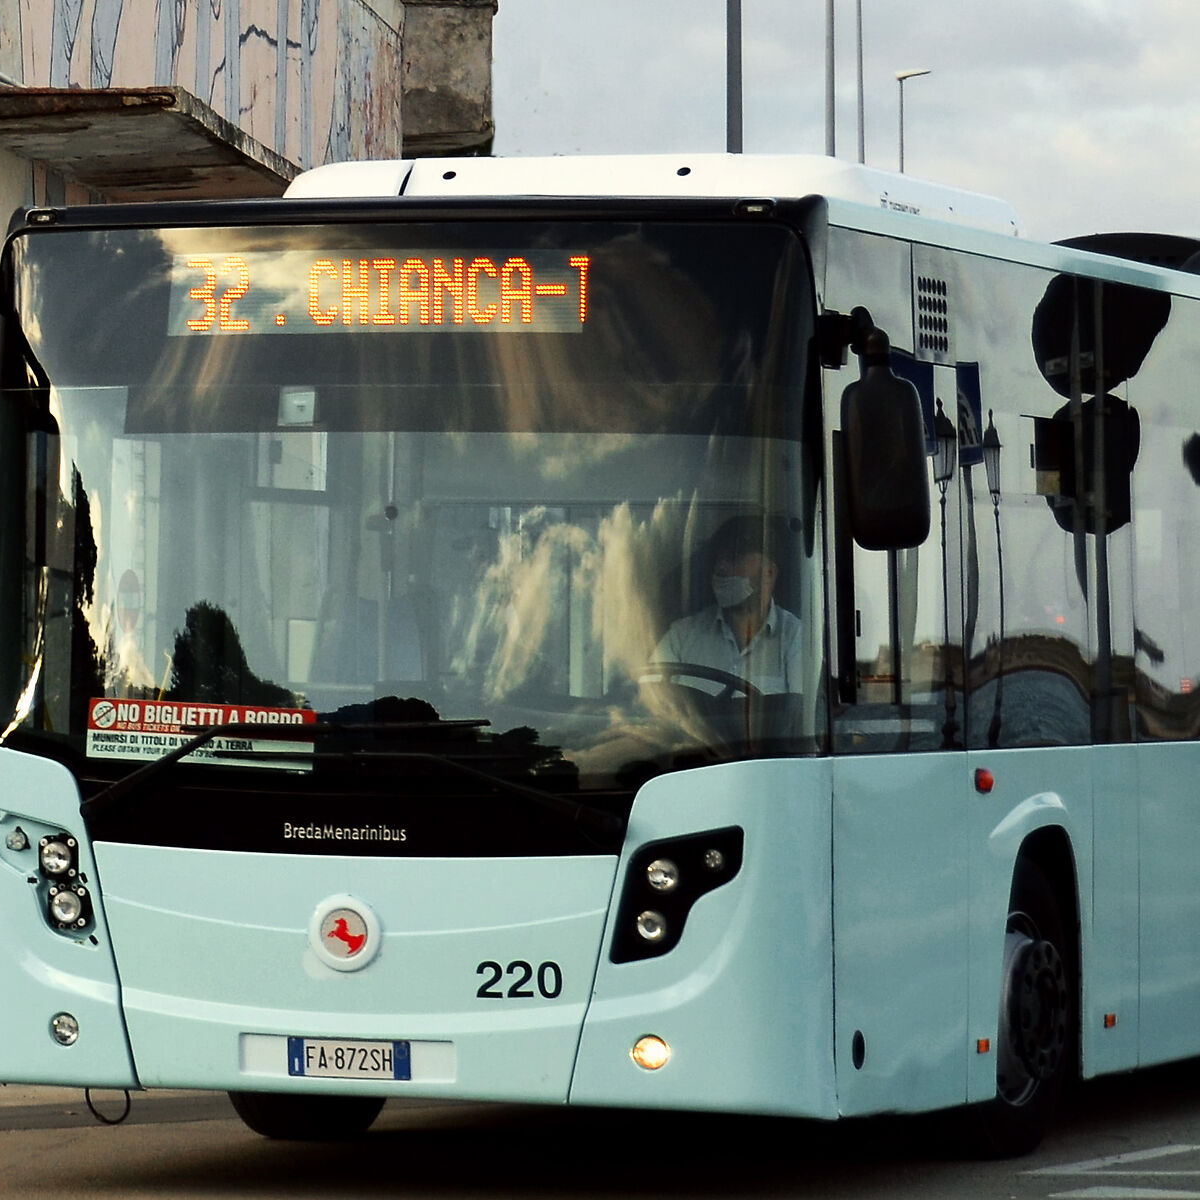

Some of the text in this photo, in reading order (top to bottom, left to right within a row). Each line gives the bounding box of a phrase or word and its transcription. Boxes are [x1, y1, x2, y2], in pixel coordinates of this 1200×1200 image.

[186, 256, 250, 332] 32
[117, 703, 140, 723] NO
[144, 705, 223, 726] BIGLIETTI
[92, 732, 128, 744] MUNIRSI
[130, 734, 138, 744] DI
[141, 735, 167, 746] TITOLI
[169, 736, 178, 746] DI
[225, 740, 253, 751] TERRA
[283, 822, 407, 842] BredaMenarinibus
[476, 960, 563, 999] 220
